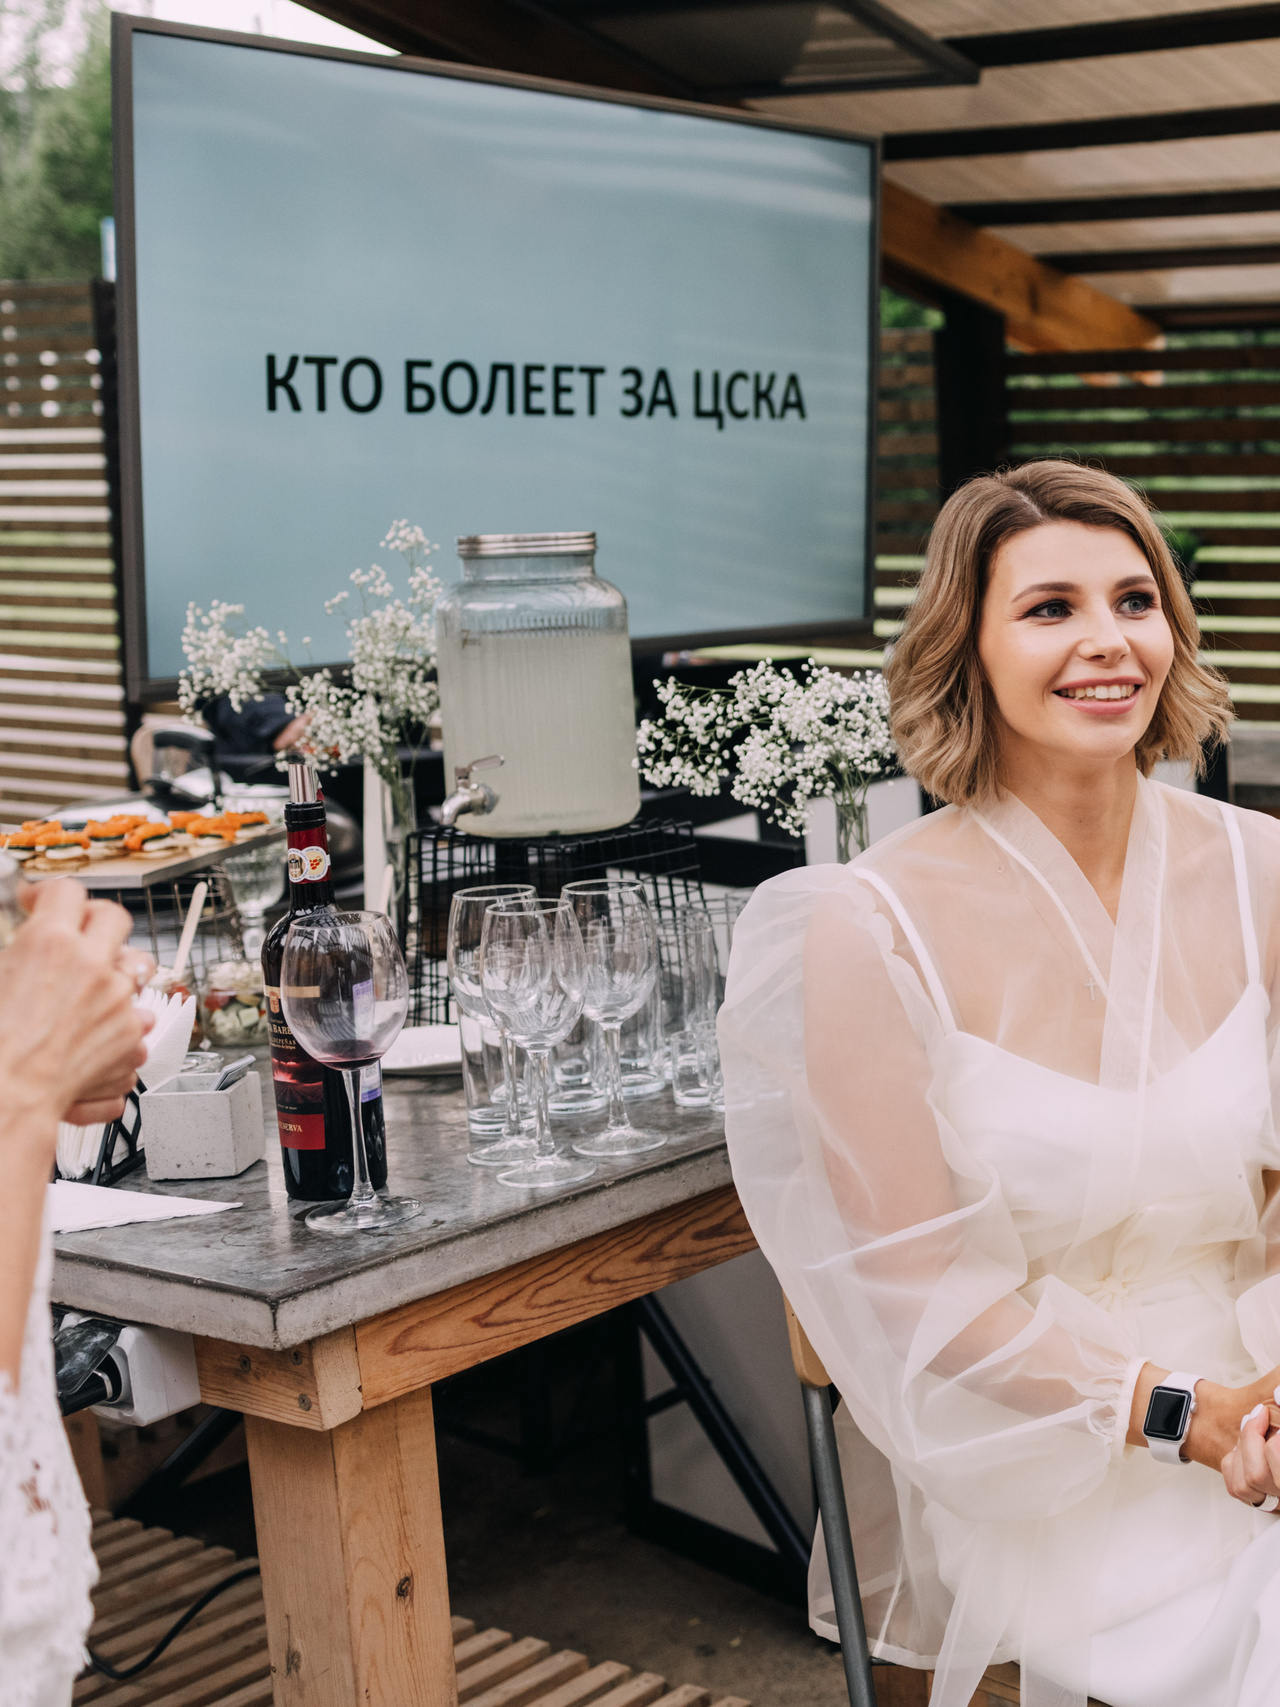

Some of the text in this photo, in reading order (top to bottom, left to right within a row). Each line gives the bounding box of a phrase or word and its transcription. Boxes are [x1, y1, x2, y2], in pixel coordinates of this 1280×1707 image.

[265, 353, 807, 431] КТО БОЛЕЕТ ЗА ЦСКА
[278, 1121, 303, 1133] ESERVA
